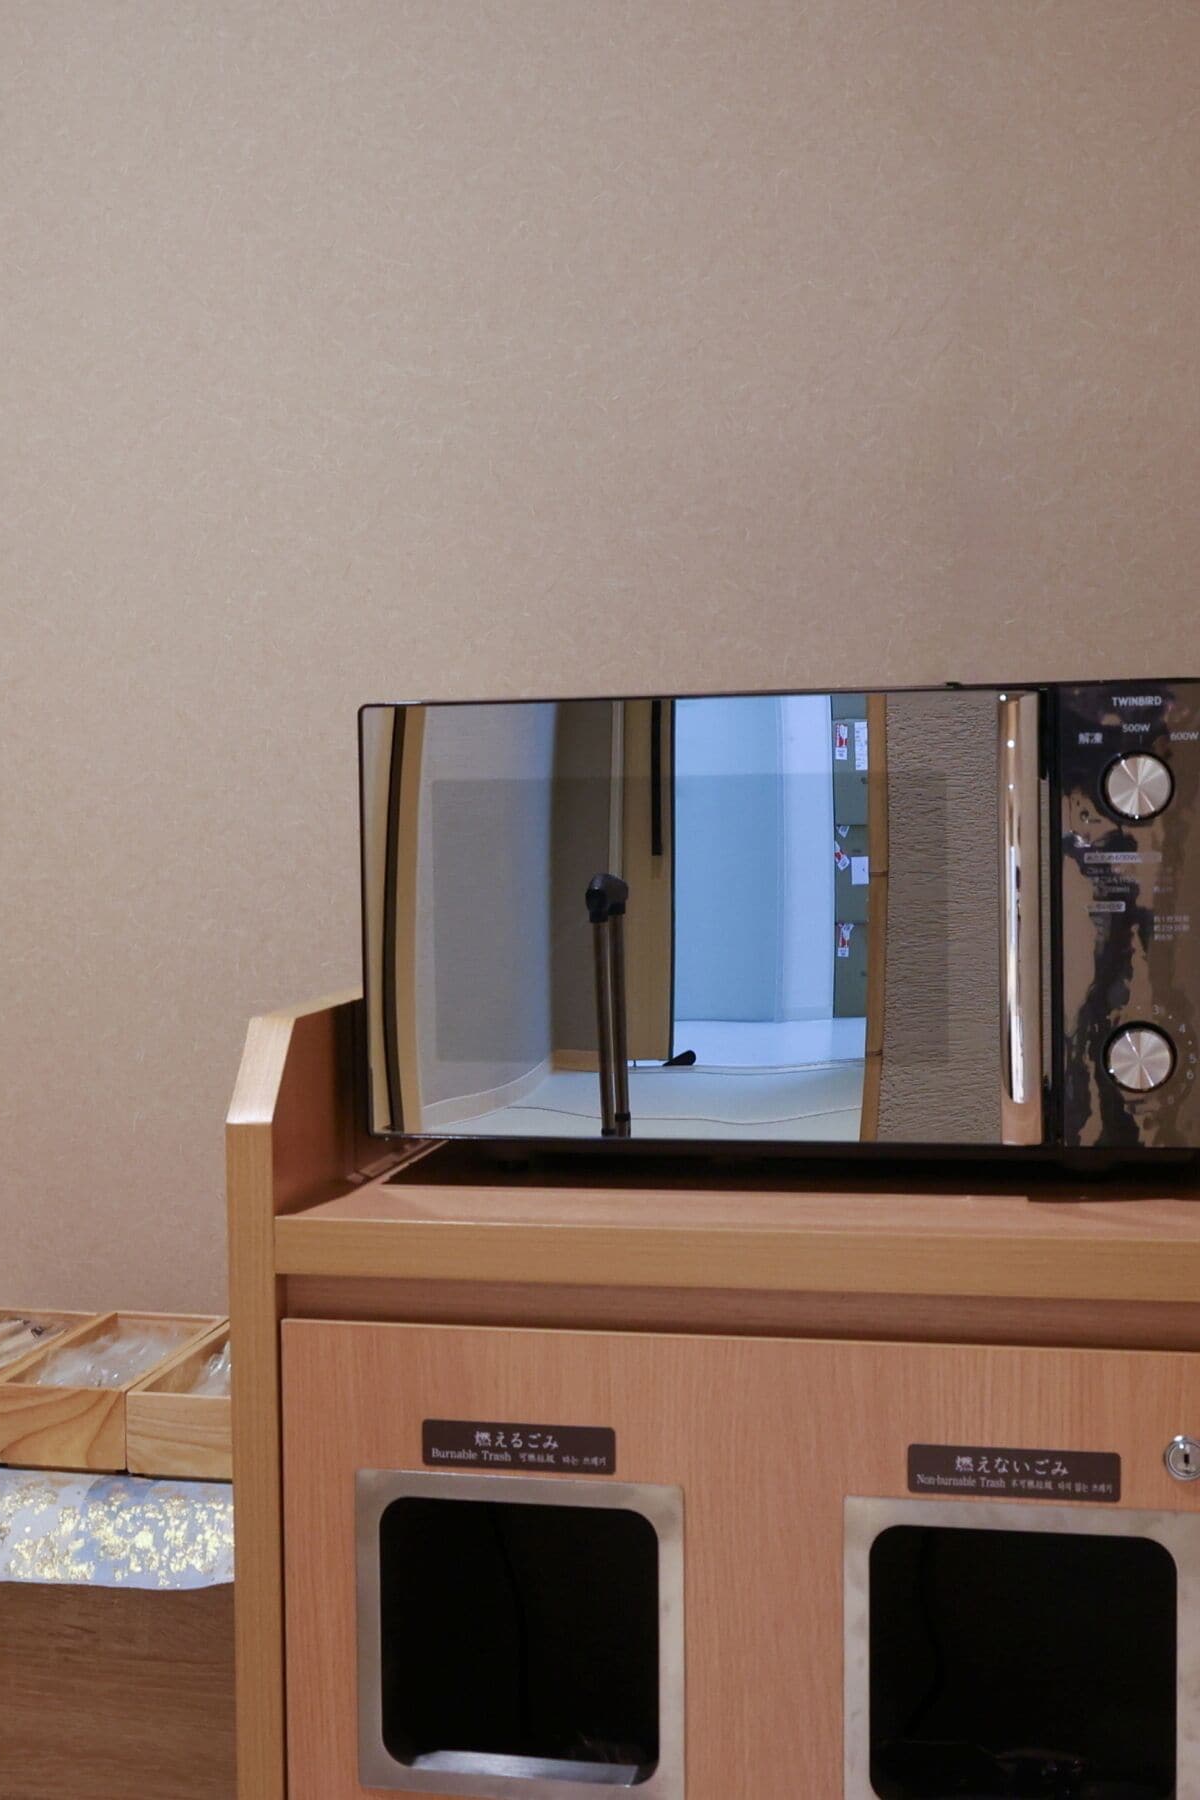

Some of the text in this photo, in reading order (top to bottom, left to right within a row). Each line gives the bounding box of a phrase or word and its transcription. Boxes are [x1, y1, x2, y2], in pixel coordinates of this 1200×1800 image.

[1112, 696, 1162, 707] TWINBIRD
[1122, 723, 1151, 733] 500W
[1170, 731, 1199, 741] 600W
[1153, 1004, 1160, 1015] 3
[1178, 1023, 1186, 1033] 4
[1187, 1070, 1194, 1080] 6
[474, 1430, 560, 1449] 燃えるごみ
[431, 1447, 478, 1460] Burnable
[481, 1450, 512, 1463] Trash
[955, 1455, 1070, 1476] 燃えないごみ
[916, 1473, 977, 1488] Non-burnable
[979, 1476, 1006, 1489] Trash
